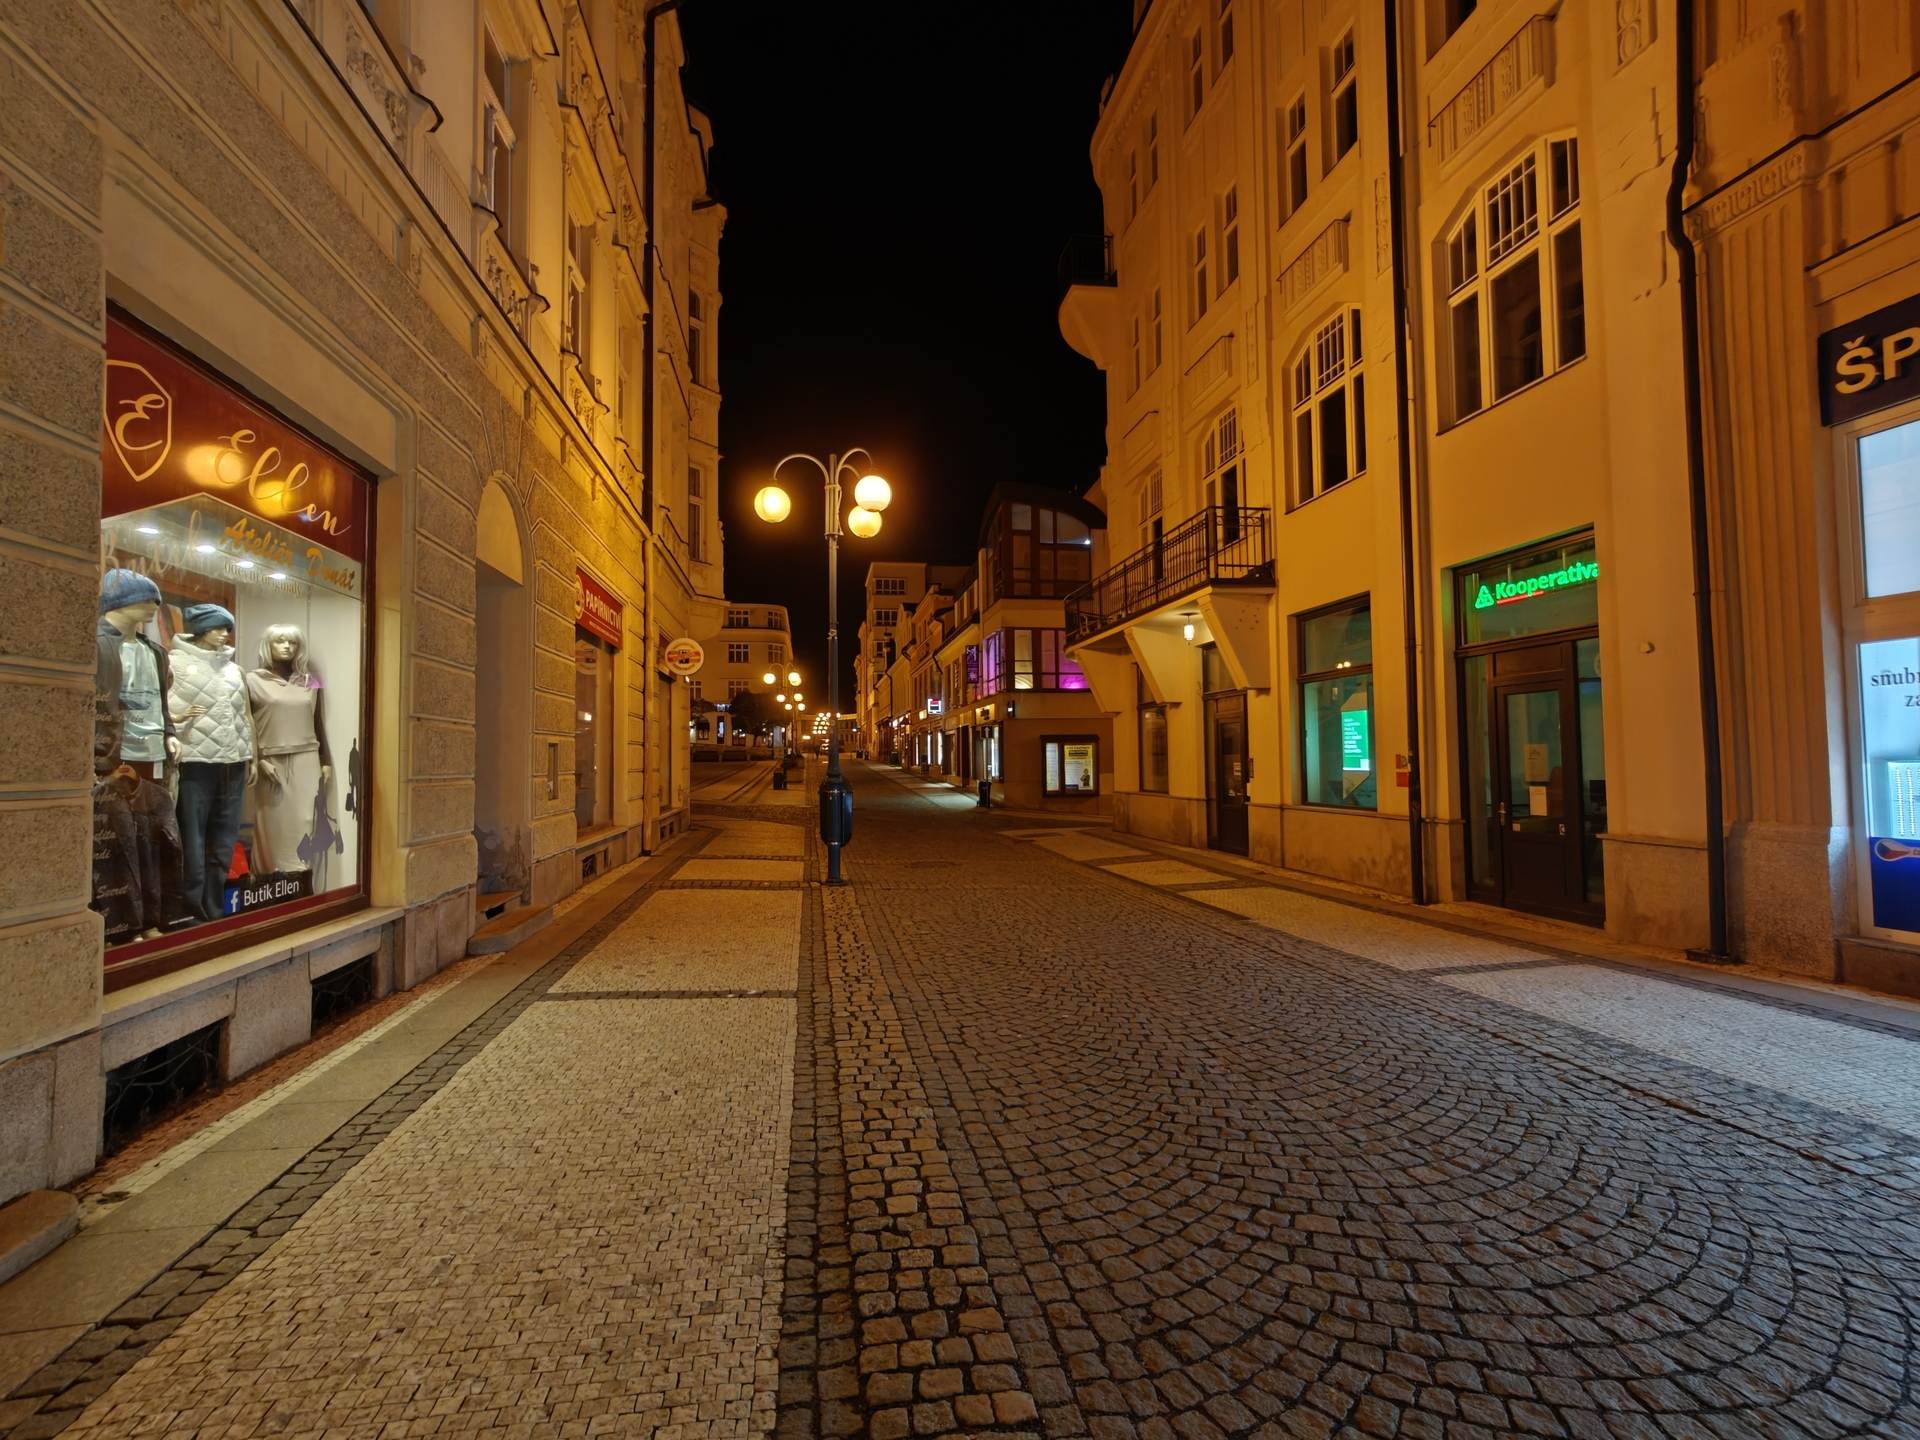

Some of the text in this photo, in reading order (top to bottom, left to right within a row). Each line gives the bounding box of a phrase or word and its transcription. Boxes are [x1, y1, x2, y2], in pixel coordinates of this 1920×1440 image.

[214, 429, 351, 536] Ellen
[1495, 561, 1598, 600] Kooperativa
[585, 589, 621, 631] PAPÍRNICTVÍ
[243, 884, 274, 907] Butik
[275, 879, 300, 898] Ellen
